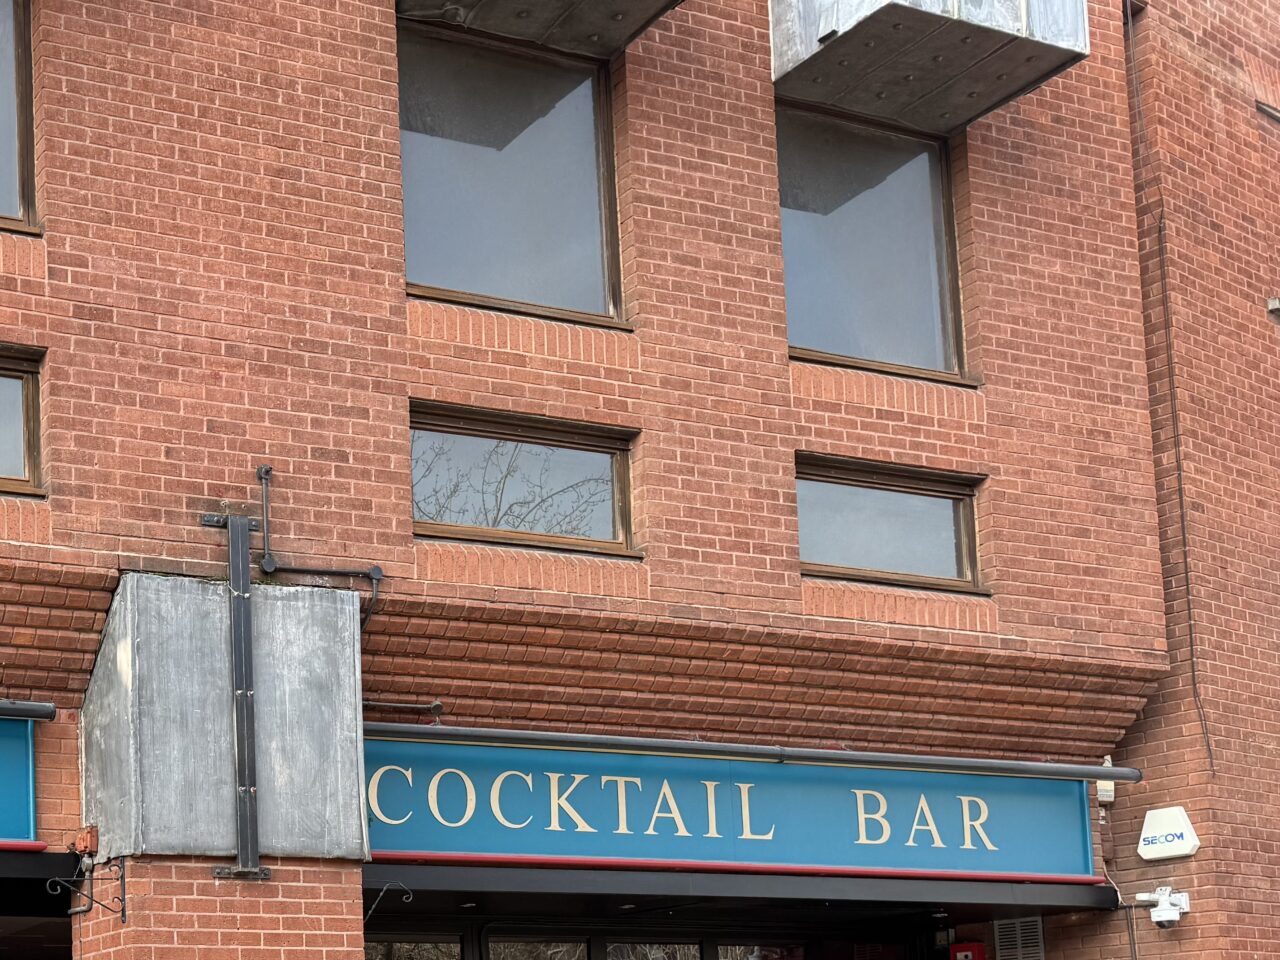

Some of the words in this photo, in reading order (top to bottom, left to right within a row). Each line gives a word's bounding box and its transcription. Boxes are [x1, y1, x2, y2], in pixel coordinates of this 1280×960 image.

[368, 765, 774, 841] COCKTAIL
[851, 788, 999, 852] BAR
[1142, 832, 1184, 846] SECOM
